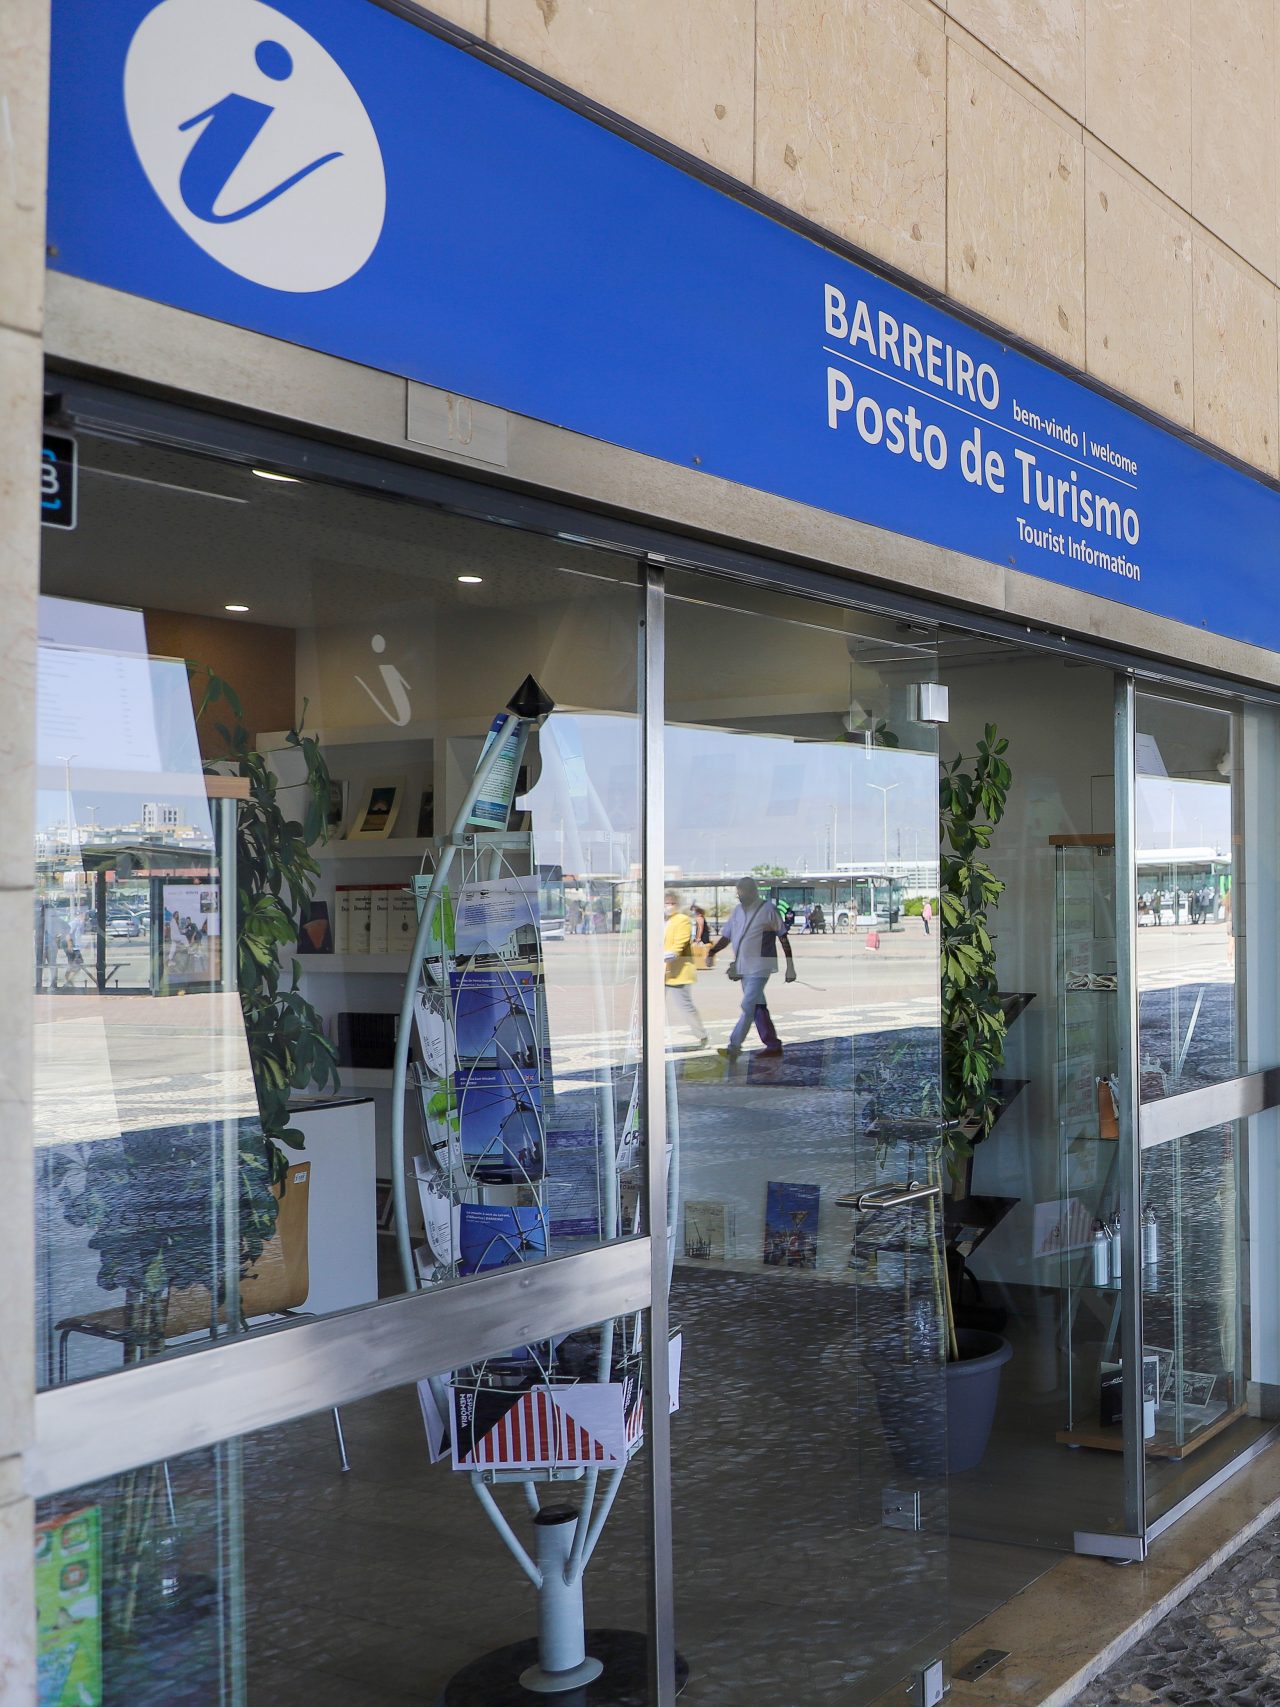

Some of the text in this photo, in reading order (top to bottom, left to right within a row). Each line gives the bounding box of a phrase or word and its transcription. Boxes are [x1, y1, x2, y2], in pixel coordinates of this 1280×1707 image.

[824, 283, 1000, 411] BARREIRO
[827, 367, 1140, 545] Posto de Turismo
[1013, 398, 1079, 448] bem-vindo
[1090, 440, 1138, 476] welcome
[1016, 516, 1141, 582] Tourist Information
[459, 1393, 468, 1428] MEMÓRIA
